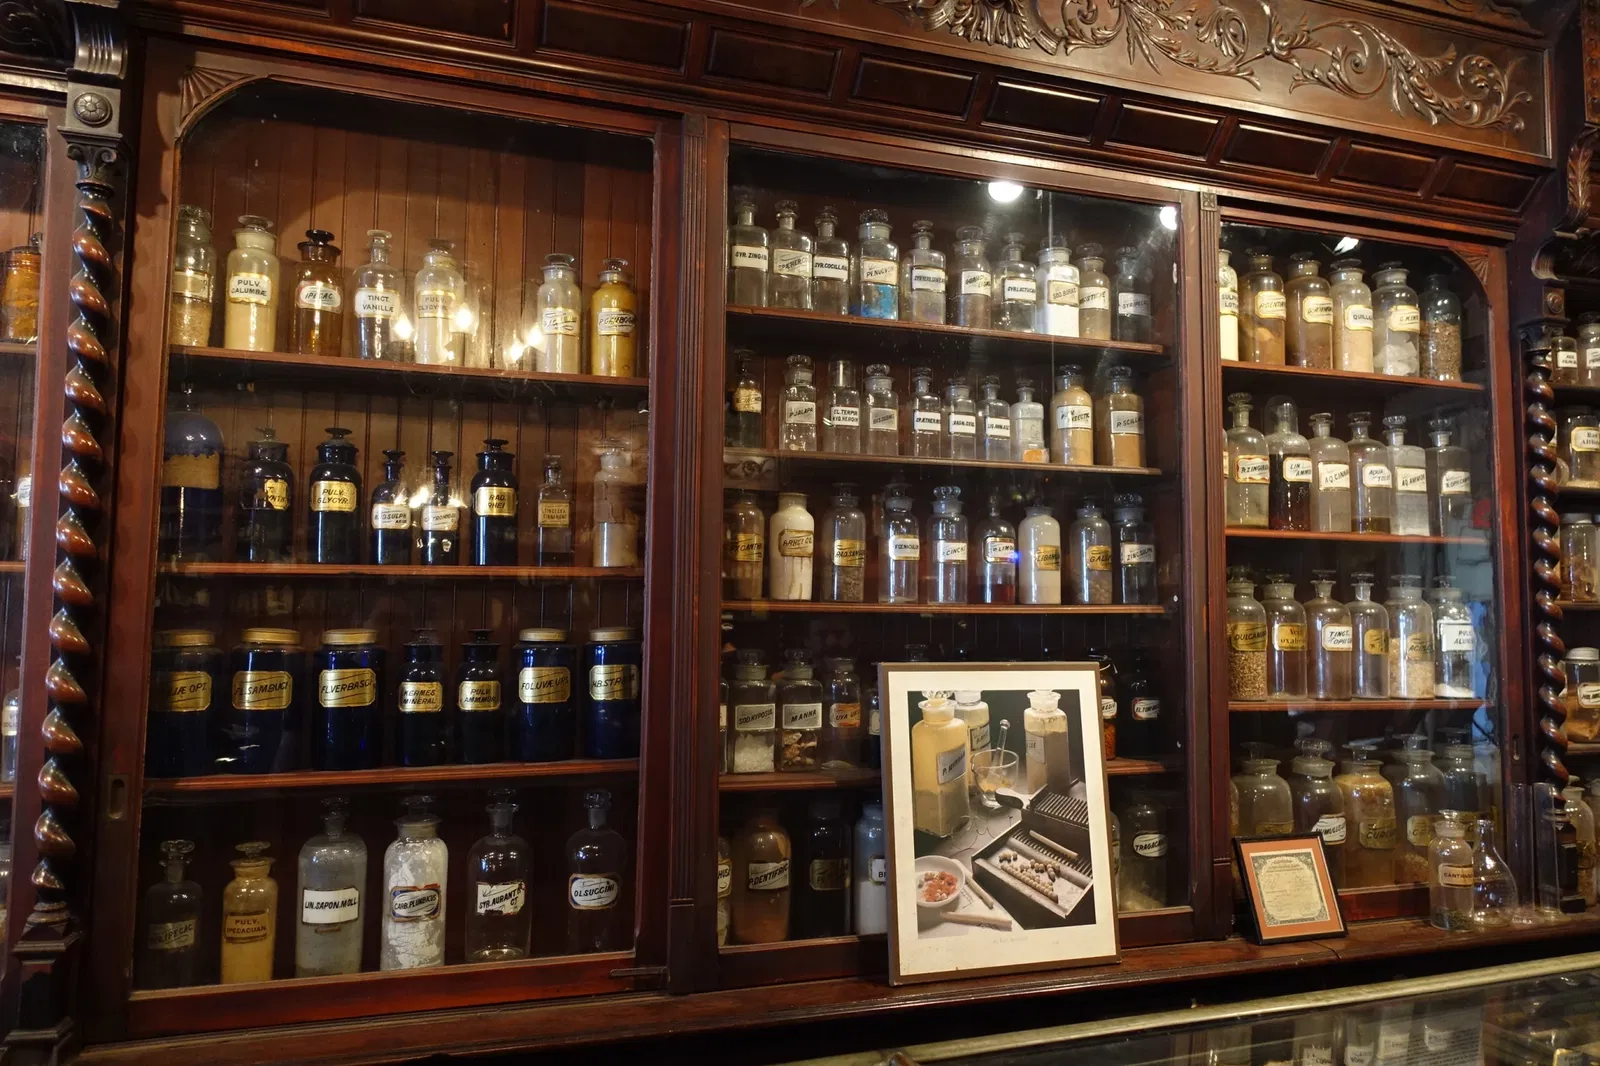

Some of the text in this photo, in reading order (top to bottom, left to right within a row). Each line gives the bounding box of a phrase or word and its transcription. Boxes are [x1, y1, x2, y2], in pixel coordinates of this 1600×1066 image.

[322, 487, 345, 498] PULV.
[488, 493, 508, 503] RAD.
[790, 708, 818, 723] MANNA
